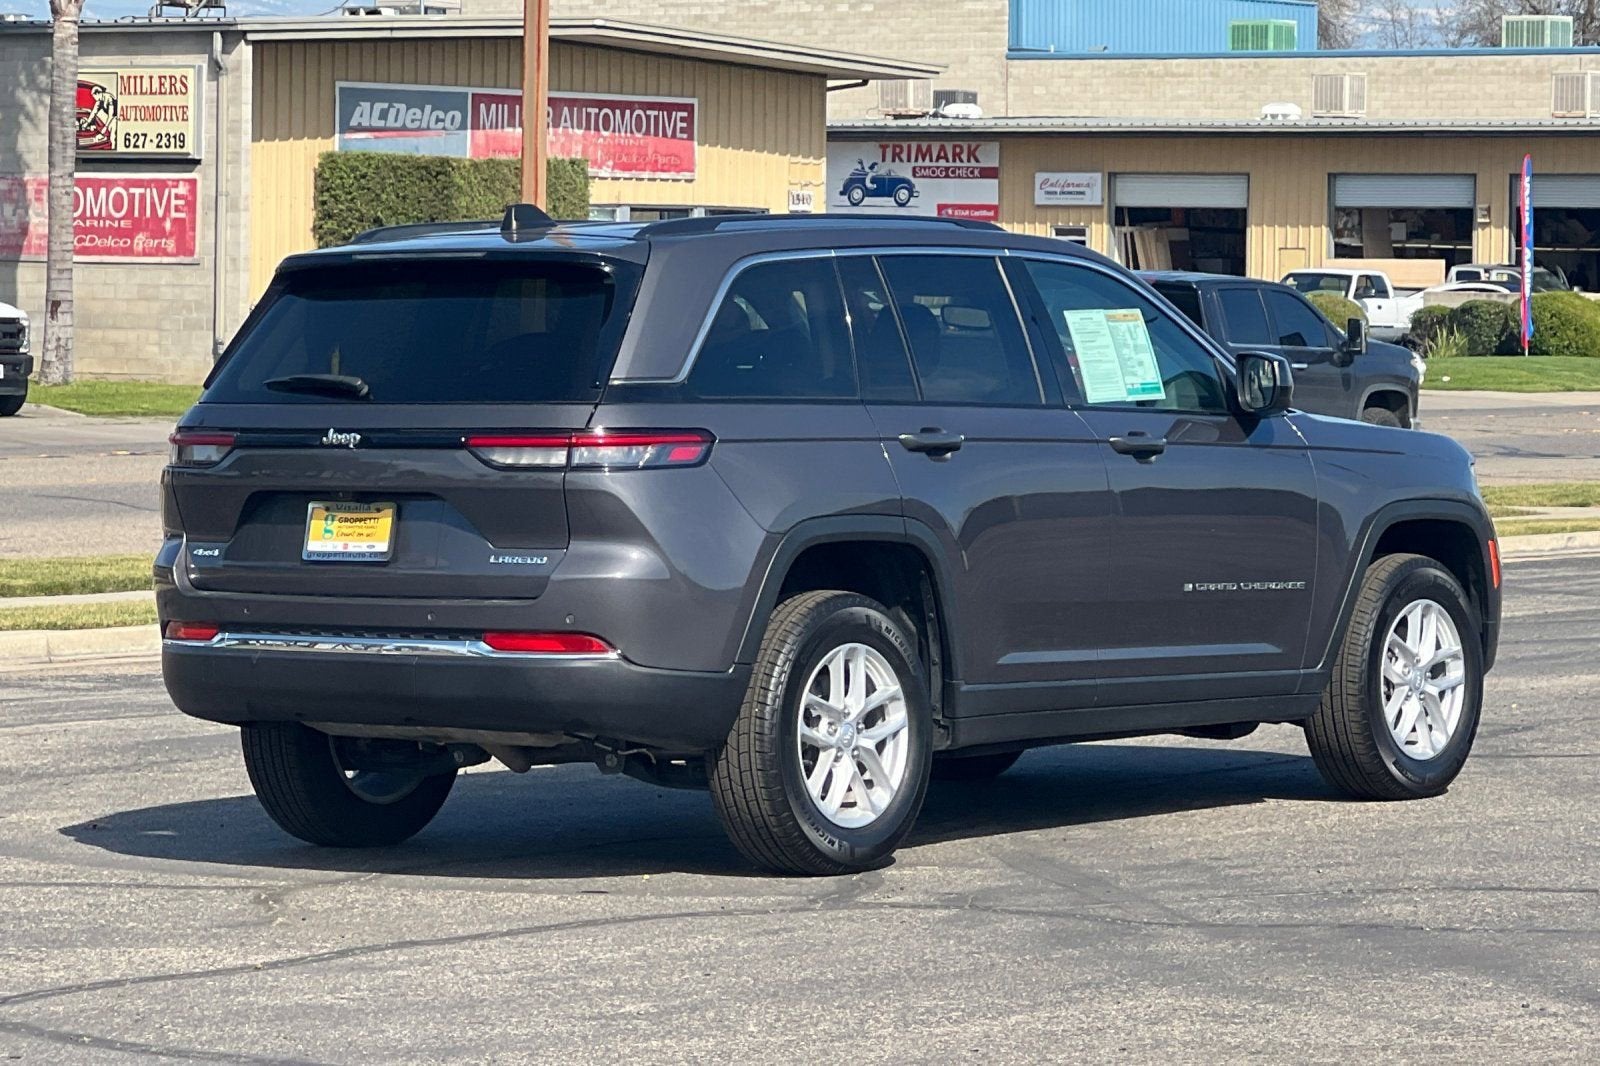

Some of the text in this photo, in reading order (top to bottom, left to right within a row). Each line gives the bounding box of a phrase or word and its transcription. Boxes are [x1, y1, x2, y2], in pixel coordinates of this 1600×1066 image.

[120, 75, 188, 96] MILLERS
[119, 105, 188, 121] AUTOMOTIVE
[350, 101, 462, 131] ACDelco
[560, 106, 689, 138] AUTOMOTIVE
[879, 143, 981, 164] TRIMARK
[915, 167, 981, 178] SMOG CHECK
[74, 219, 133, 229] ARINE
[74, 233, 175, 249] CDelco Parts
[322, 428, 361, 449] Jeep
[335, 503, 371, 512] Visalia
[338, 516, 379, 525] GROPPETTI
[490, 554, 548, 564] LAREDO
[1195, 581, 1306, 591] GRAND CHEROKEE
